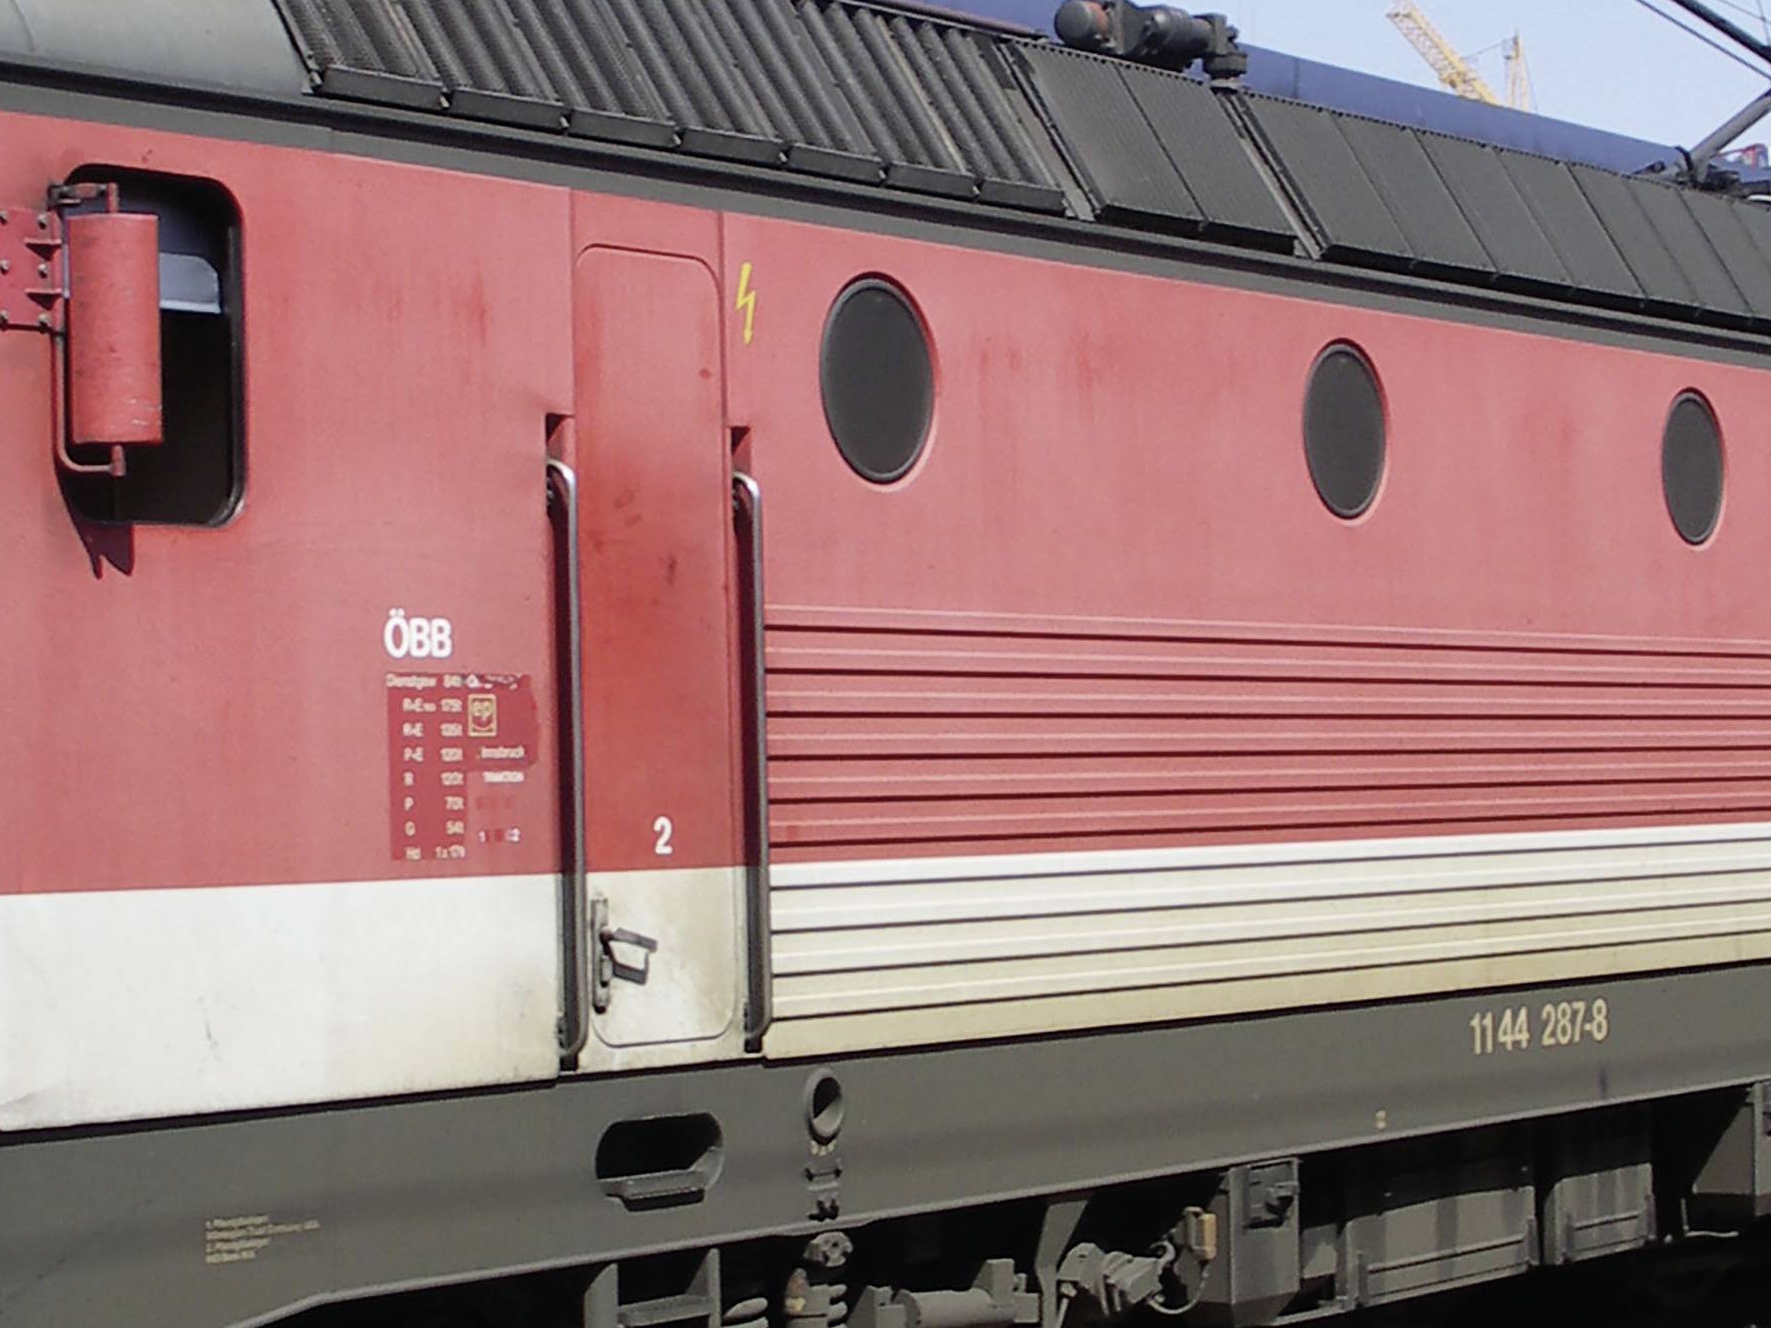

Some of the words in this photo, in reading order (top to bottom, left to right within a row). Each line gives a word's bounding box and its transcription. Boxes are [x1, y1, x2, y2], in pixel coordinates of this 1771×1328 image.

[383, 607, 453, 659] ÖBB
[653, 816, 673, 855] 2
[1469, 1006, 1530, 1055] 1144
[1541, 997, 1608, 1047] 287-8
